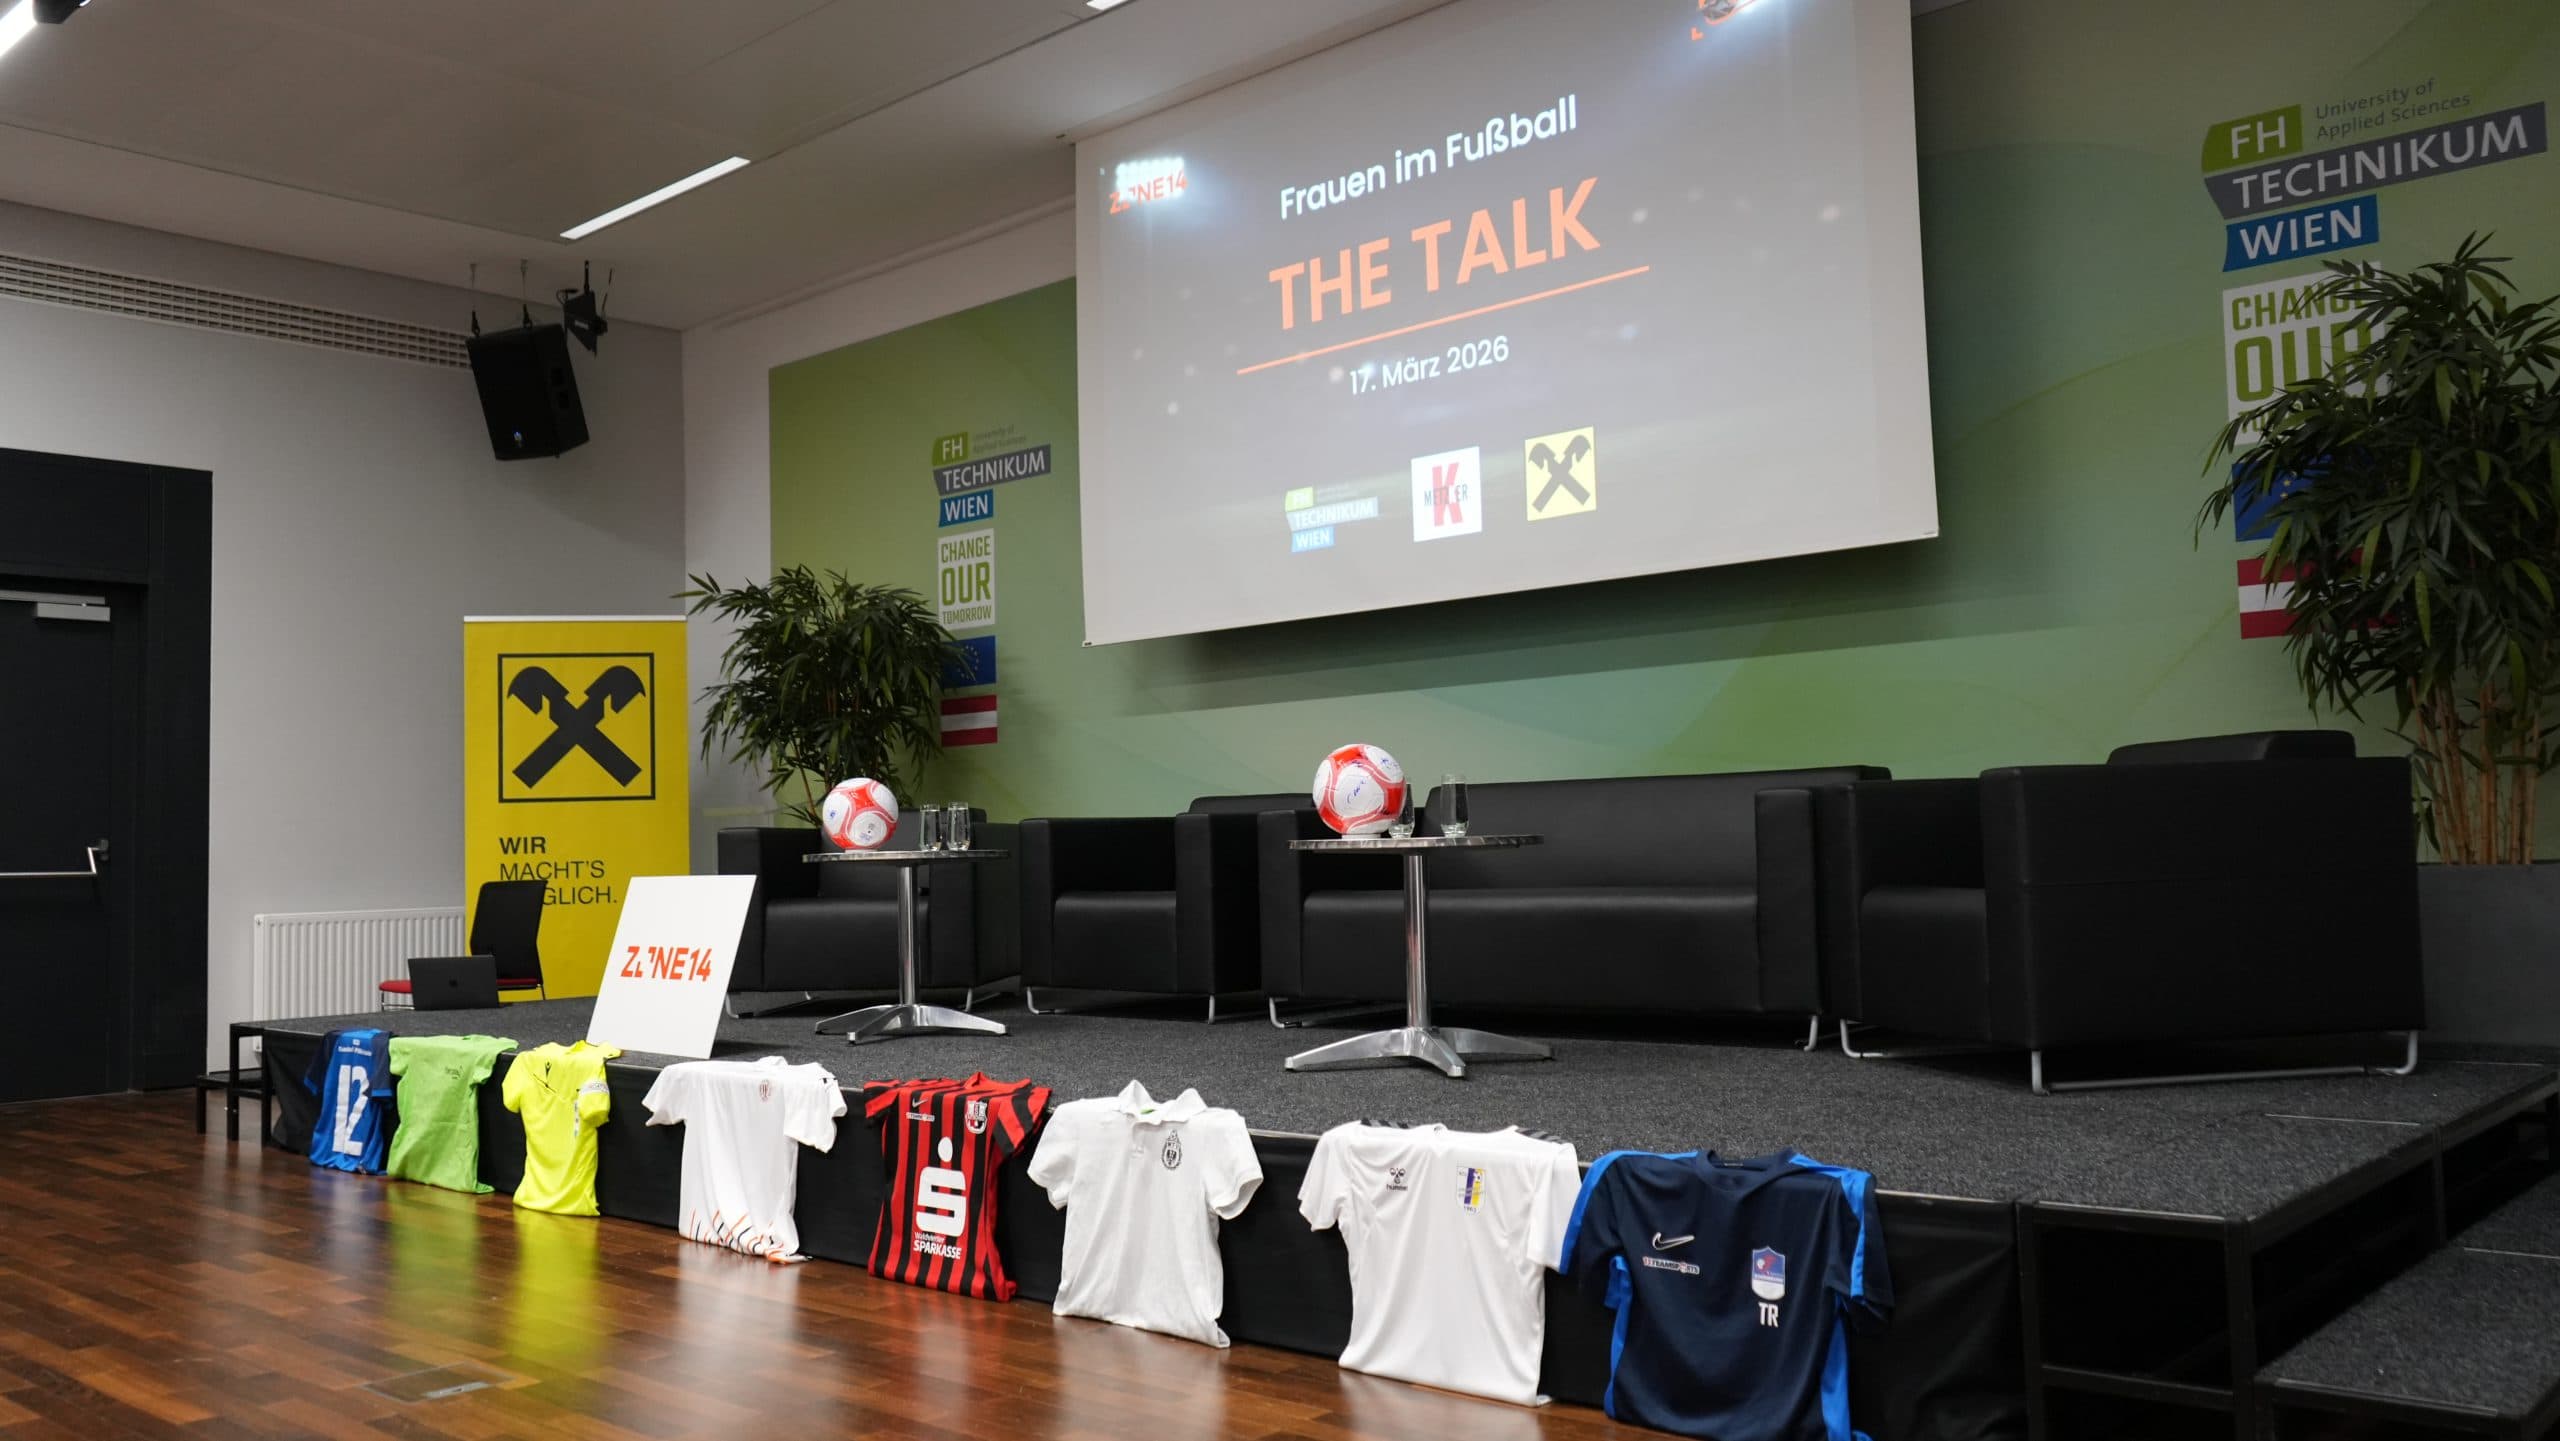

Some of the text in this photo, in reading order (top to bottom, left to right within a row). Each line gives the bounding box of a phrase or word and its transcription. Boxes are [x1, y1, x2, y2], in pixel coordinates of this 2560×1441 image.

[2315, 77, 2436, 121] University of
[2316, 93, 2471, 144] Applied Sciences
[2229, 114, 2287, 160] FH
[1280, 93, 1577, 220] Frauen im Fußball
[2232, 114, 2529, 209] TECHNIKUM
[2239, 204, 2362, 260] WIEN
[1269, 177, 1601, 330] THE TALK
[1350, 335, 1509, 395] 17. März 2026
[942, 436, 963, 461] FH
[943, 450, 1045, 491] TECHNIKUM
[944, 494, 988, 522] WIEN
[1294, 500, 1374, 527] TECHNIKUM
[941, 535, 991, 563] CHANGE
[1296, 530, 1330, 548] WIEN
[942, 561, 992, 606] OUR
[942, 605, 992, 625] TOMORROW
[499, 836, 546, 855] WIR
[500, 859, 605, 881] MACHT'S
[543, 886, 617, 905] GLICH.
[332, 1064, 369, 1156] 12
[913, 1239, 962, 1260] SPARKASSE
[1757, 1301, 1779, 1328] TR
